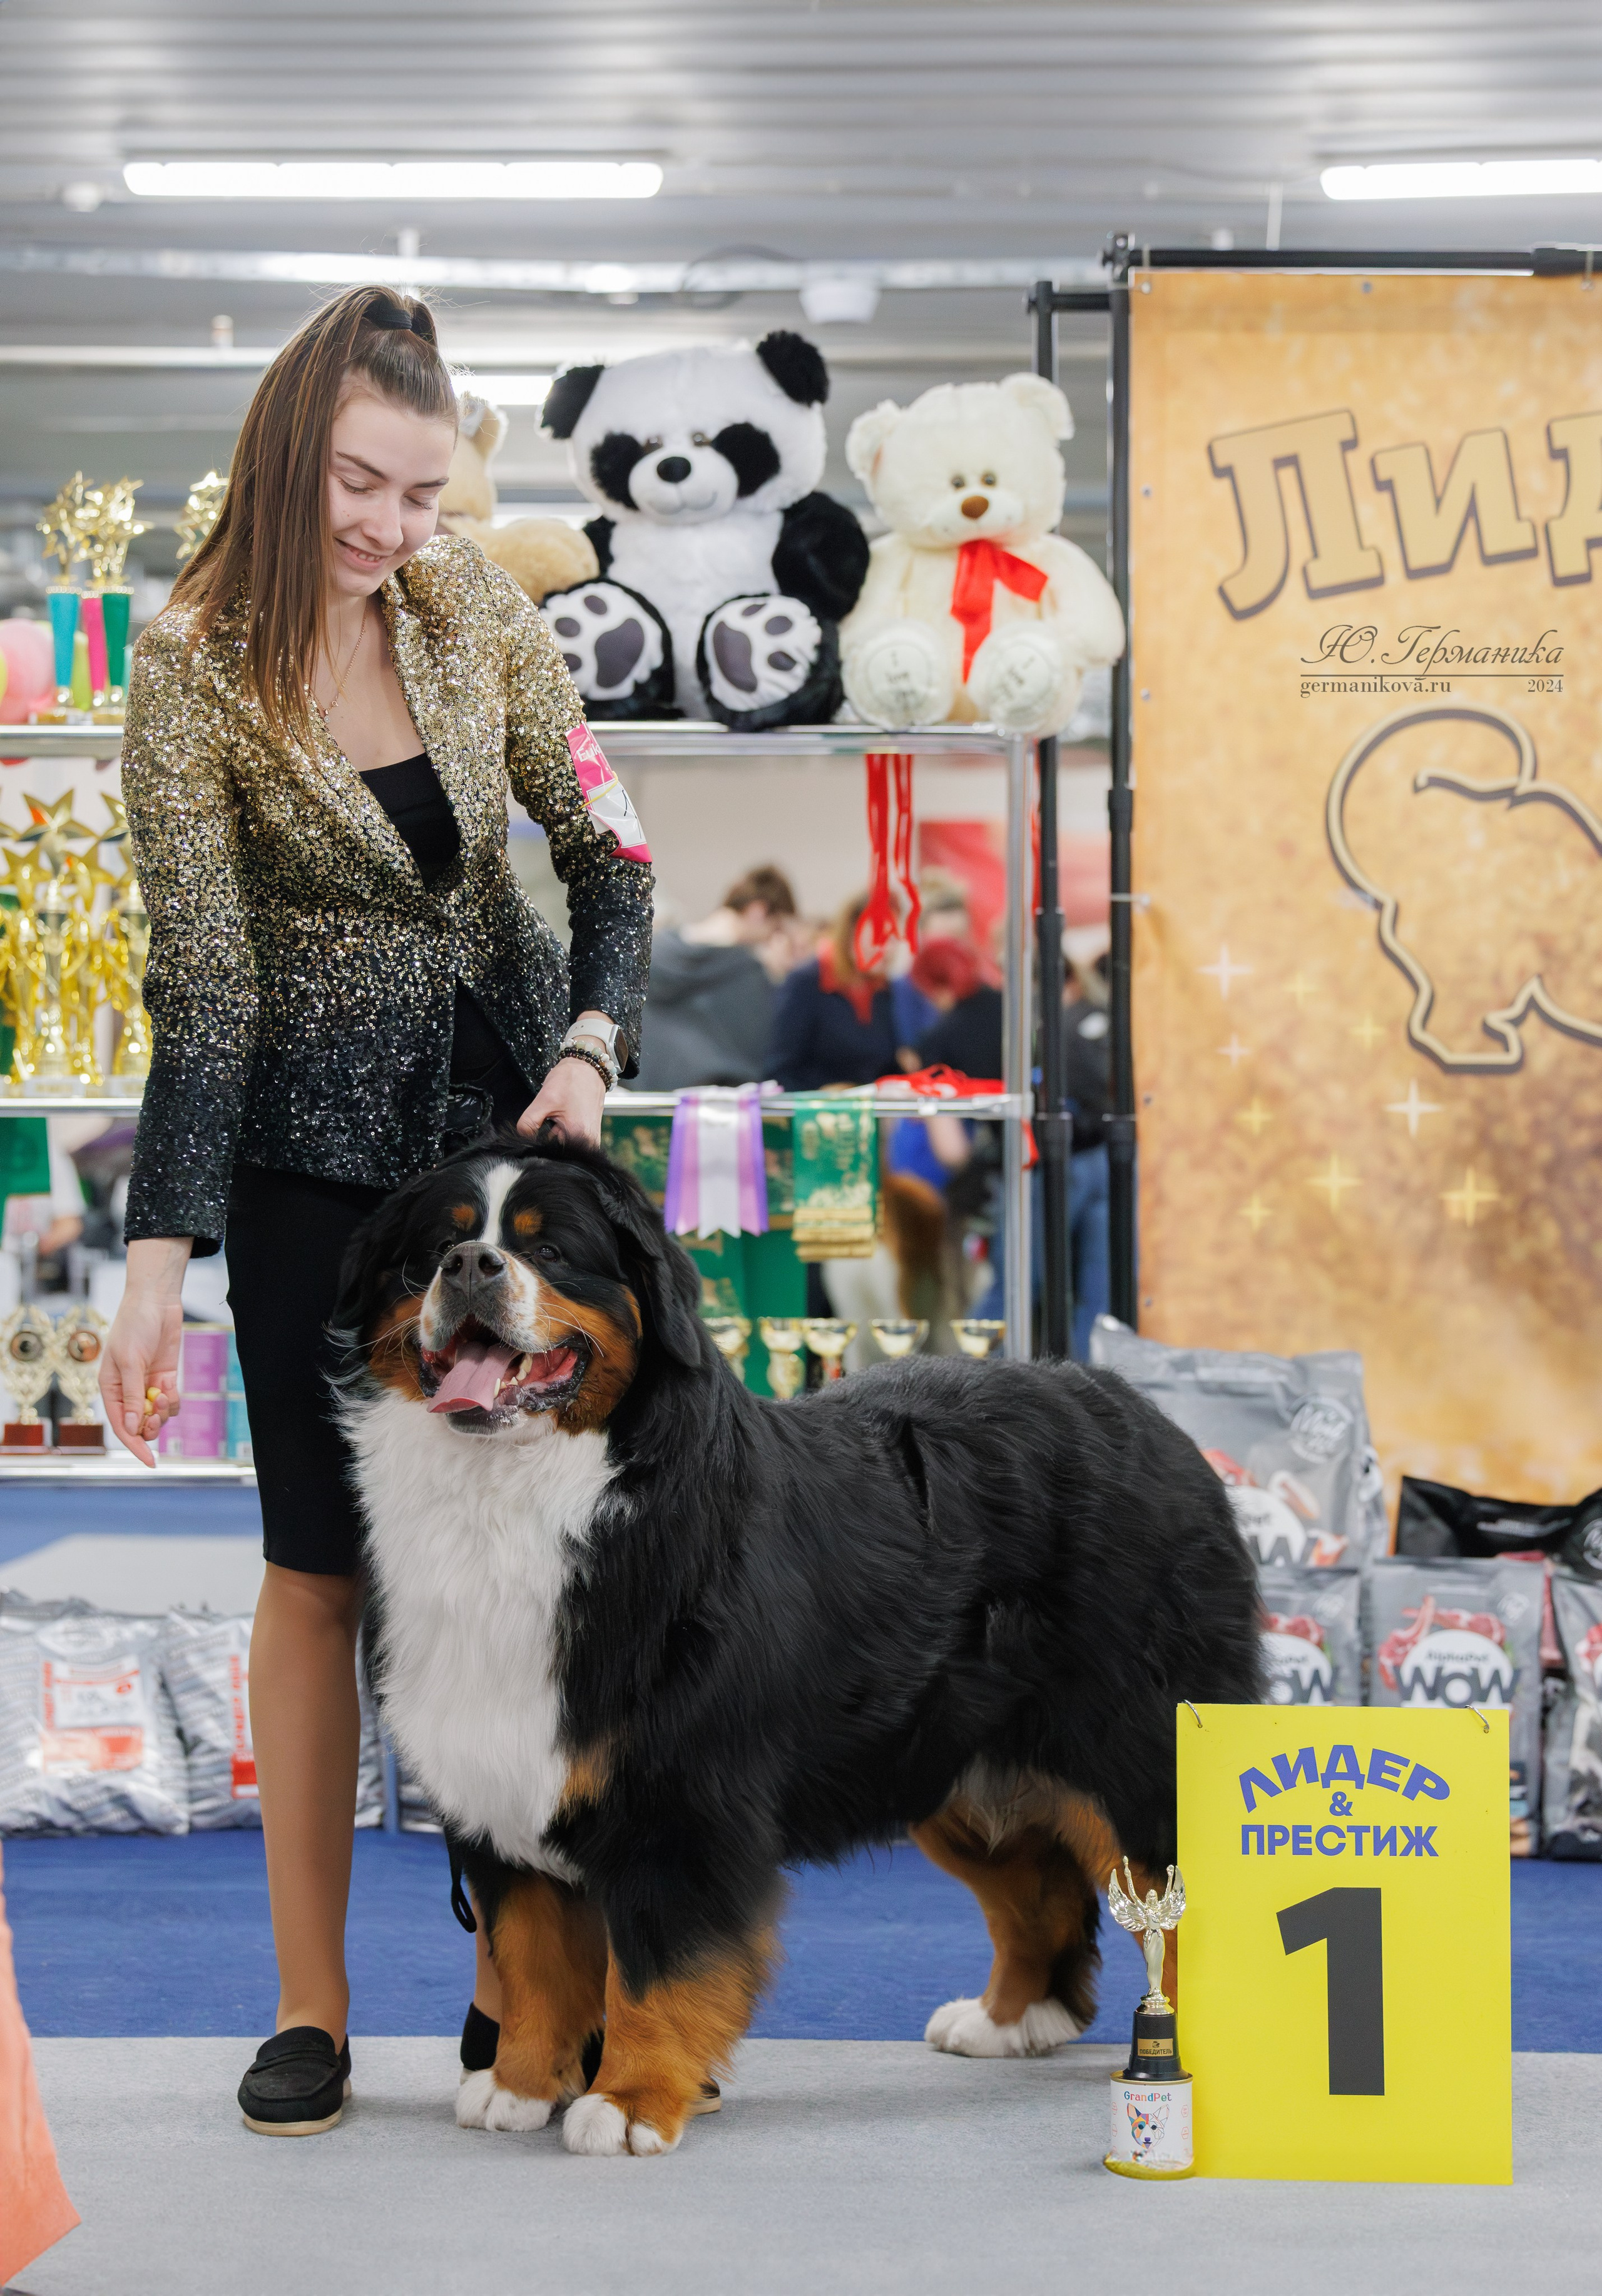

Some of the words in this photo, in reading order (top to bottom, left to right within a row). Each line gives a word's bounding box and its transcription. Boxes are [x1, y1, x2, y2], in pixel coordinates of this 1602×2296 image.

[1394, 1665, 1521, 1708] WOW
[1238, 1744, 1451, 1814] ЛИДЕР
[1329, 1791, 1354, 1817] &
[1241, 1824, 1439, 1857] ПРЕСТИЖ
[1276, 1887, 1385, 2096] 1
[1124, 2091, 1172, 2102] GrandPet
